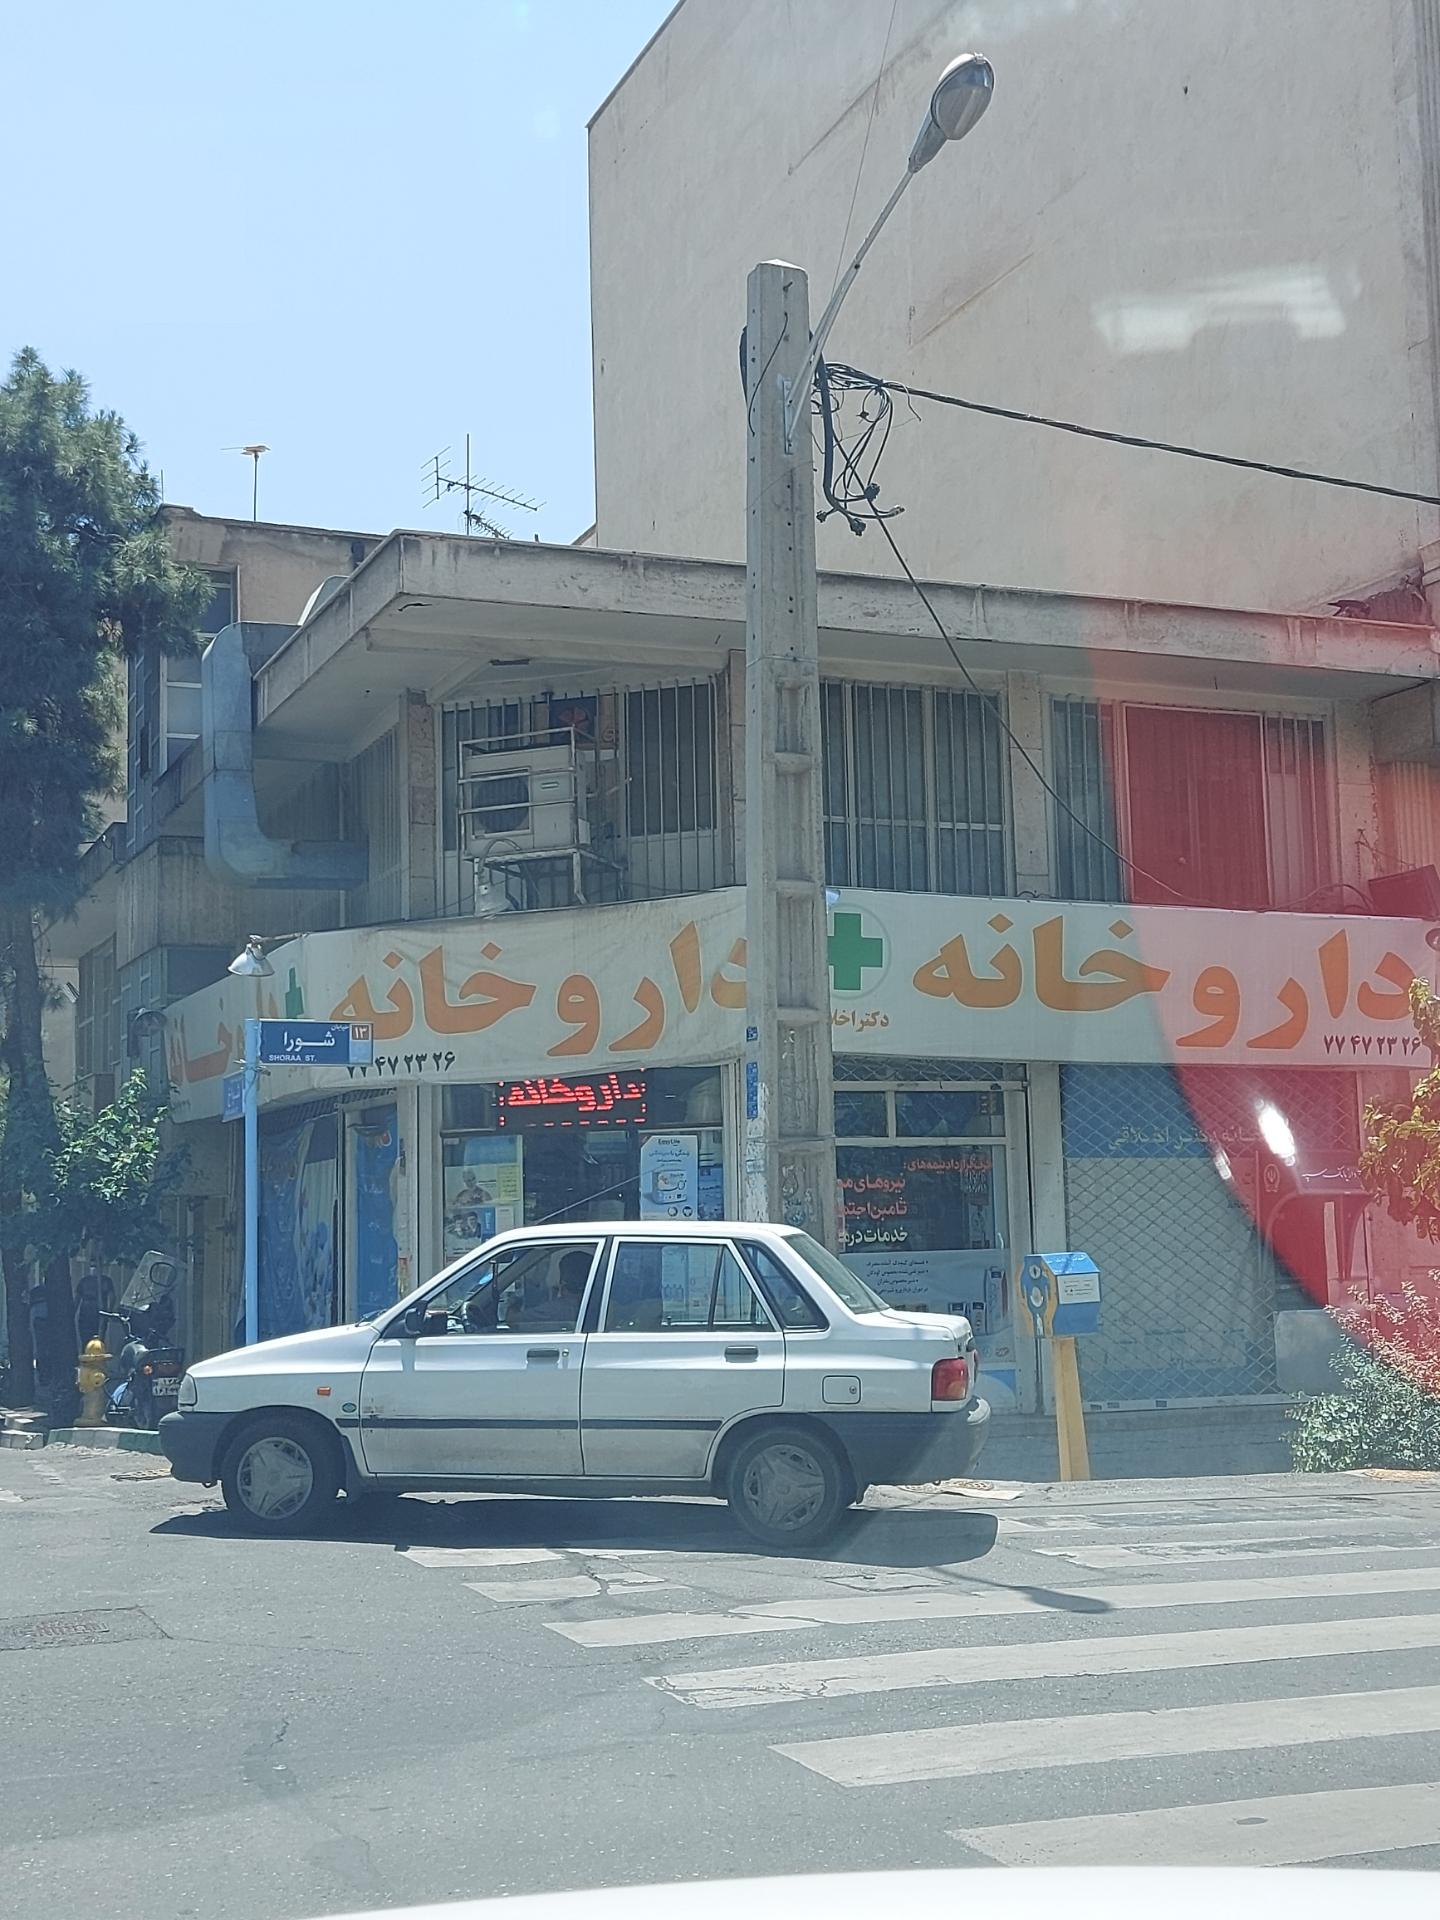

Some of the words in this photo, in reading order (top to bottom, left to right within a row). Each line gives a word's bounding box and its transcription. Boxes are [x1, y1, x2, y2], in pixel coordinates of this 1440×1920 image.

[329, 919, 747, 1058] داروخانه
[912, 912, 1415, 1049] داروخانه
[855, 1010, 889, 1032] دکتر
[284, 1030, 335, 1052] شورا
[354, 1026, 368, 1039] ۱۳
[1323, 1034, 1345, 1055] ۷۷
[1350, 1035, 1372, 1056] ۴۷
[1376, 1036, 1398, 1056] ۲۳
[268, 1054, 301, 1062] SHORAA
[305, 1054, 317, 1062] ST.
[507, 1073, 643, 1112] داروخانه
[854, 1172, 906, 1194] نیروهای
[864, 1226, 909, 1243] خدمات
